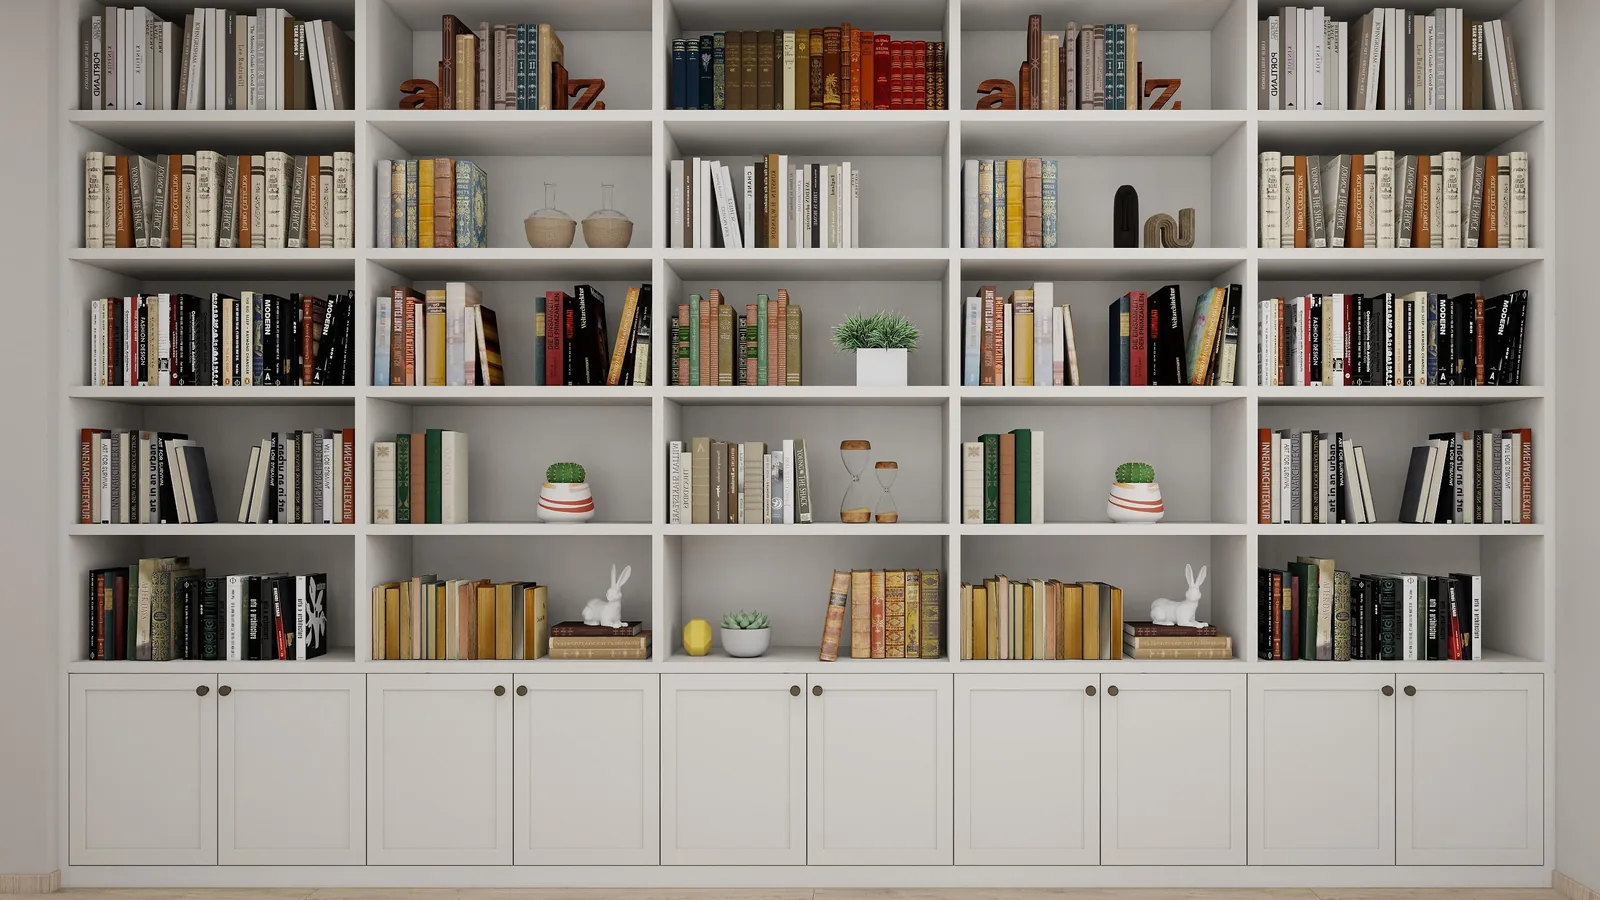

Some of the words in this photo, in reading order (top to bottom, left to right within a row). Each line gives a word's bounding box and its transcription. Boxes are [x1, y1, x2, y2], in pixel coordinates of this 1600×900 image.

[1314, 210, 1322, 231] SHACK
[322, 300, 334, 336] MODERN
[579, 288, 587, 328] Weltarchitektur
[1170, 288, 1178, 328] Weltarchitektur
[1498, 300, 1509, 335] MODERN
[151, 474, 156, 485] an
[1262, 442, 1270, 519] INNENARCHITEKTUR
[1292, 433, 1300, 510] INNENARCHITEKTUR
[1330, 474, 1336, 485] an
[149, 488, 156, 497] in
[1328, 488, 1336, 497] in
